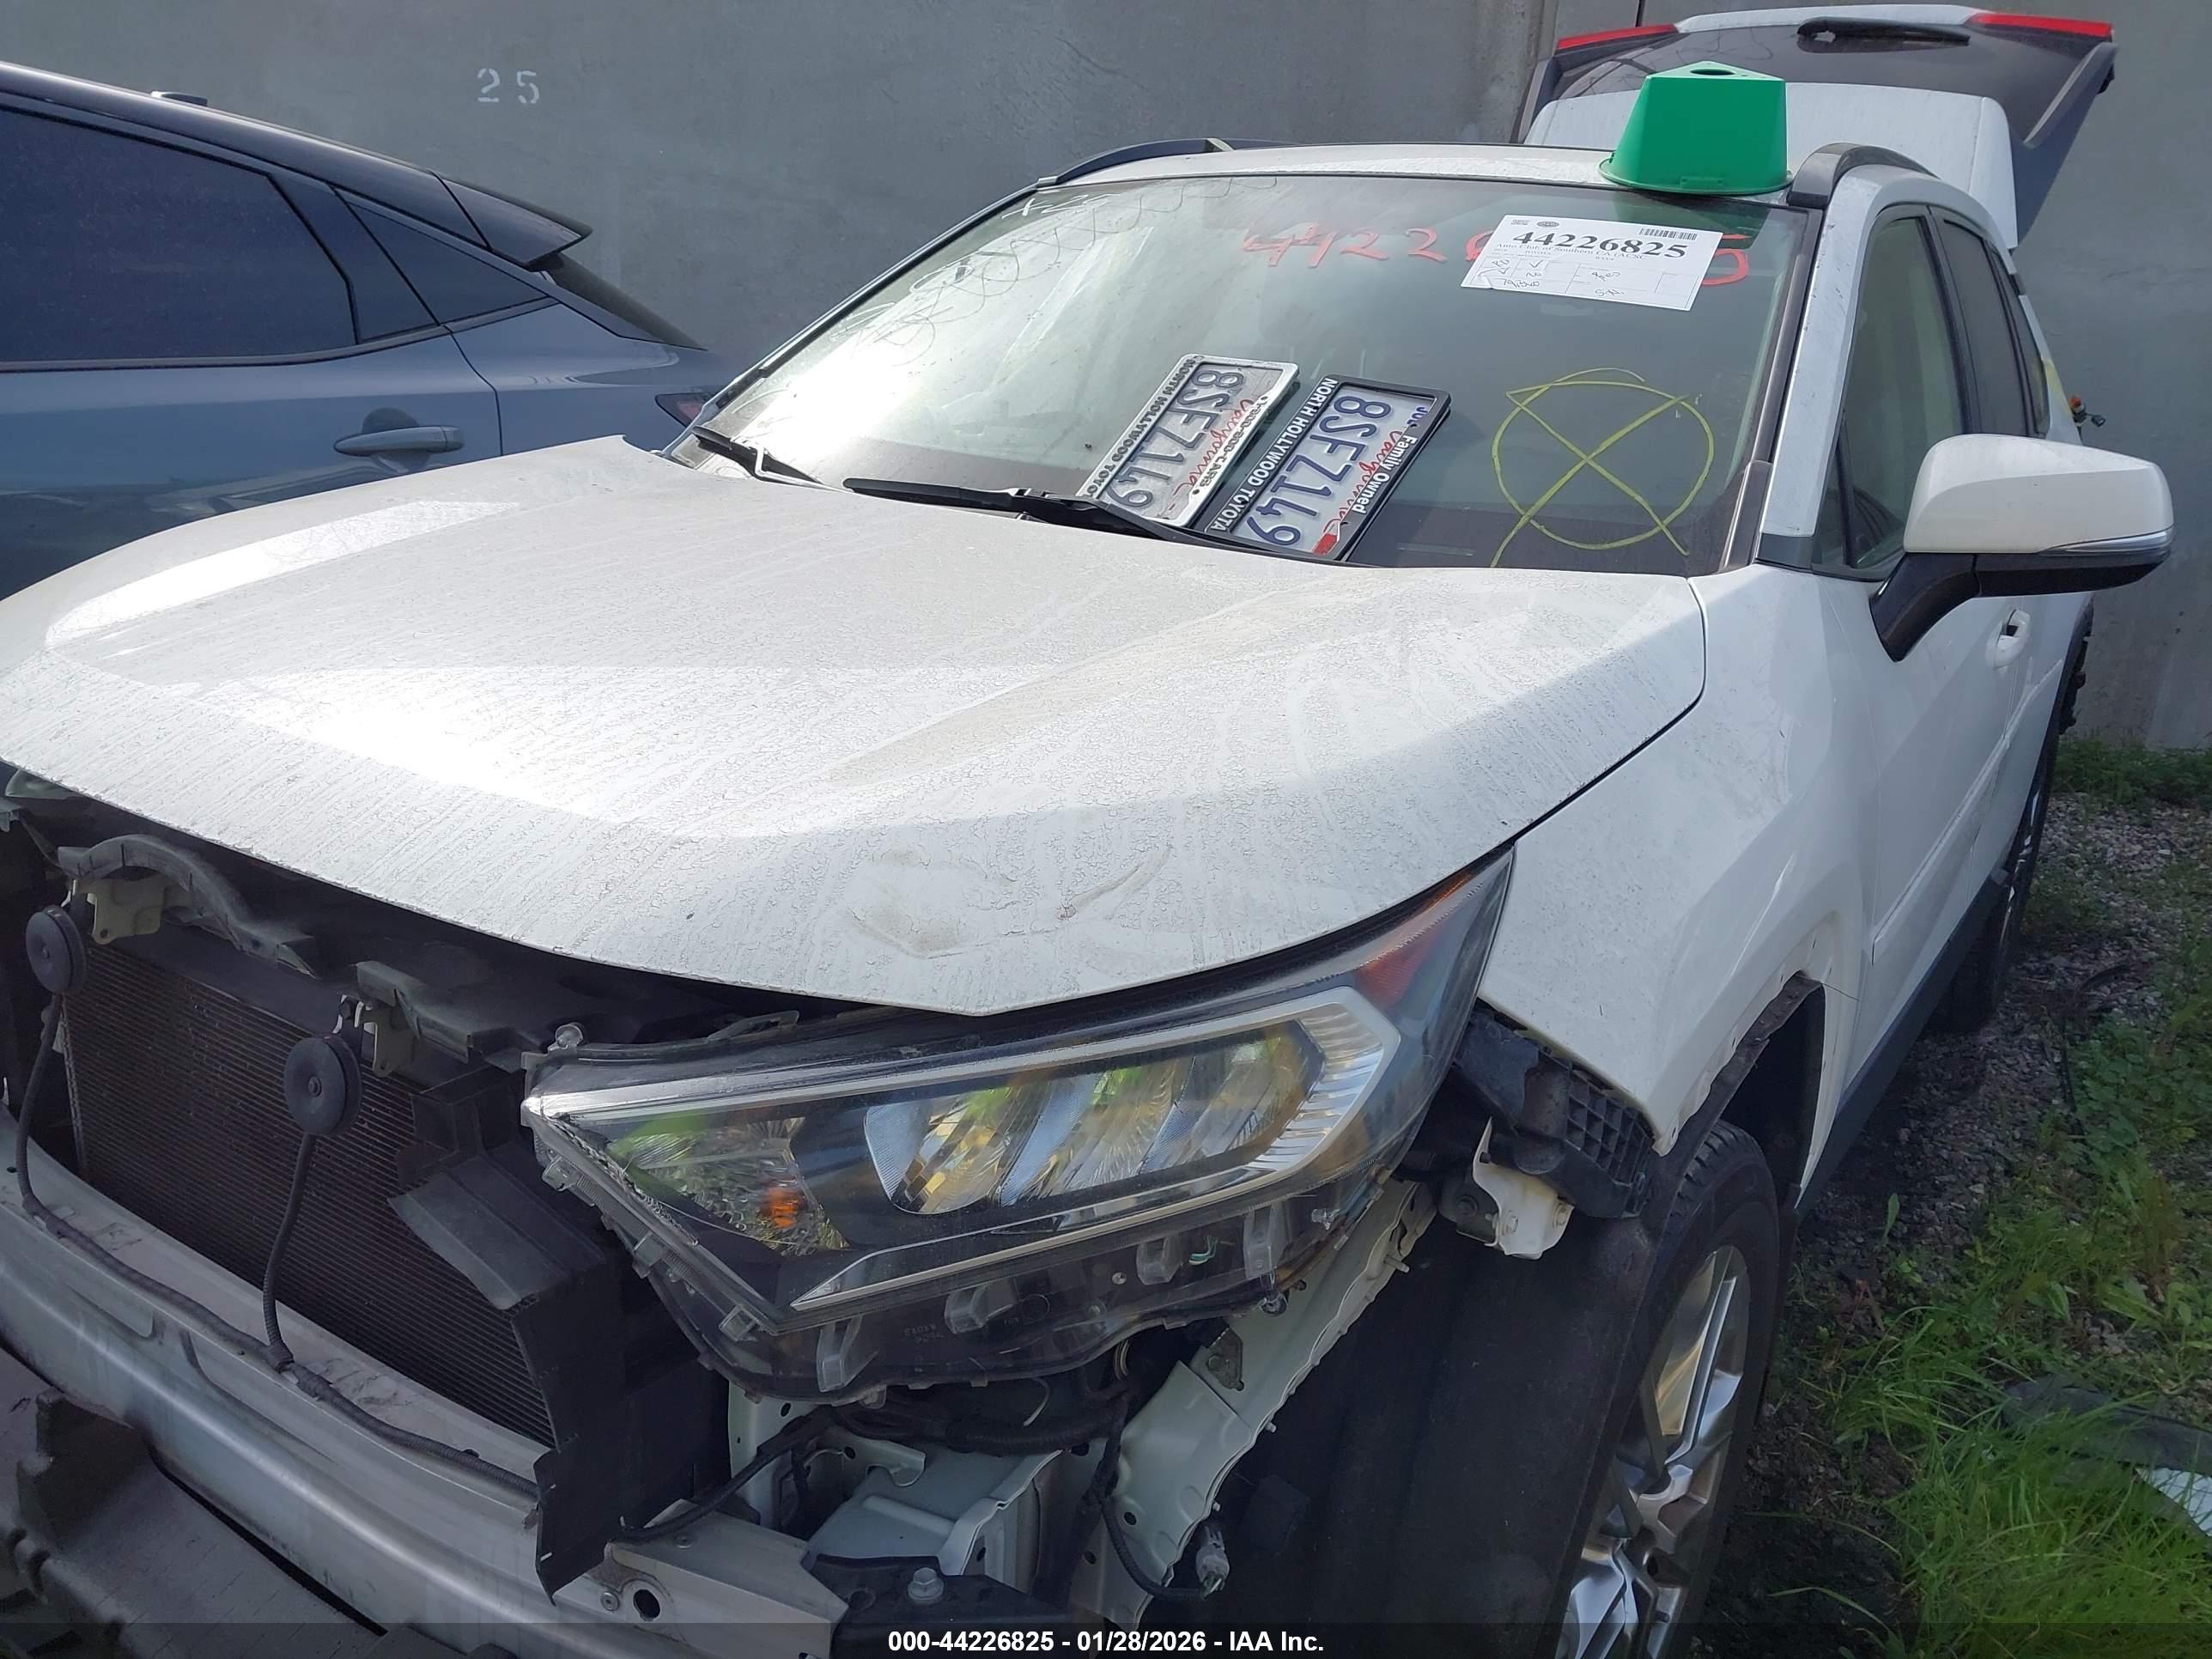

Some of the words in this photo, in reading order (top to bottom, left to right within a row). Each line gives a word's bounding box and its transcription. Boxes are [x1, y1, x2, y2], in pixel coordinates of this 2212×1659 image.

[477, 68, 540, 104] 25
[1513, 231, 1689, 258] 44226825
[1162, 358, 1196, 396] NORTH
[1300, 377, 1339, 416] NORTH
[1106, 368, 1244, 507] 8SFZ149
[1111, 396, 1169, 462] HOLLYWOOD
[1243, 395, 1391, 546] 8SFZ149
[1248, 416, 1310, 486] HOLLYWOOD
[1380, 434, 1418, 471] Family
[1211, 488, 1256, 532] TOYOTA
[1352, 474, 1390, 514] Owned
